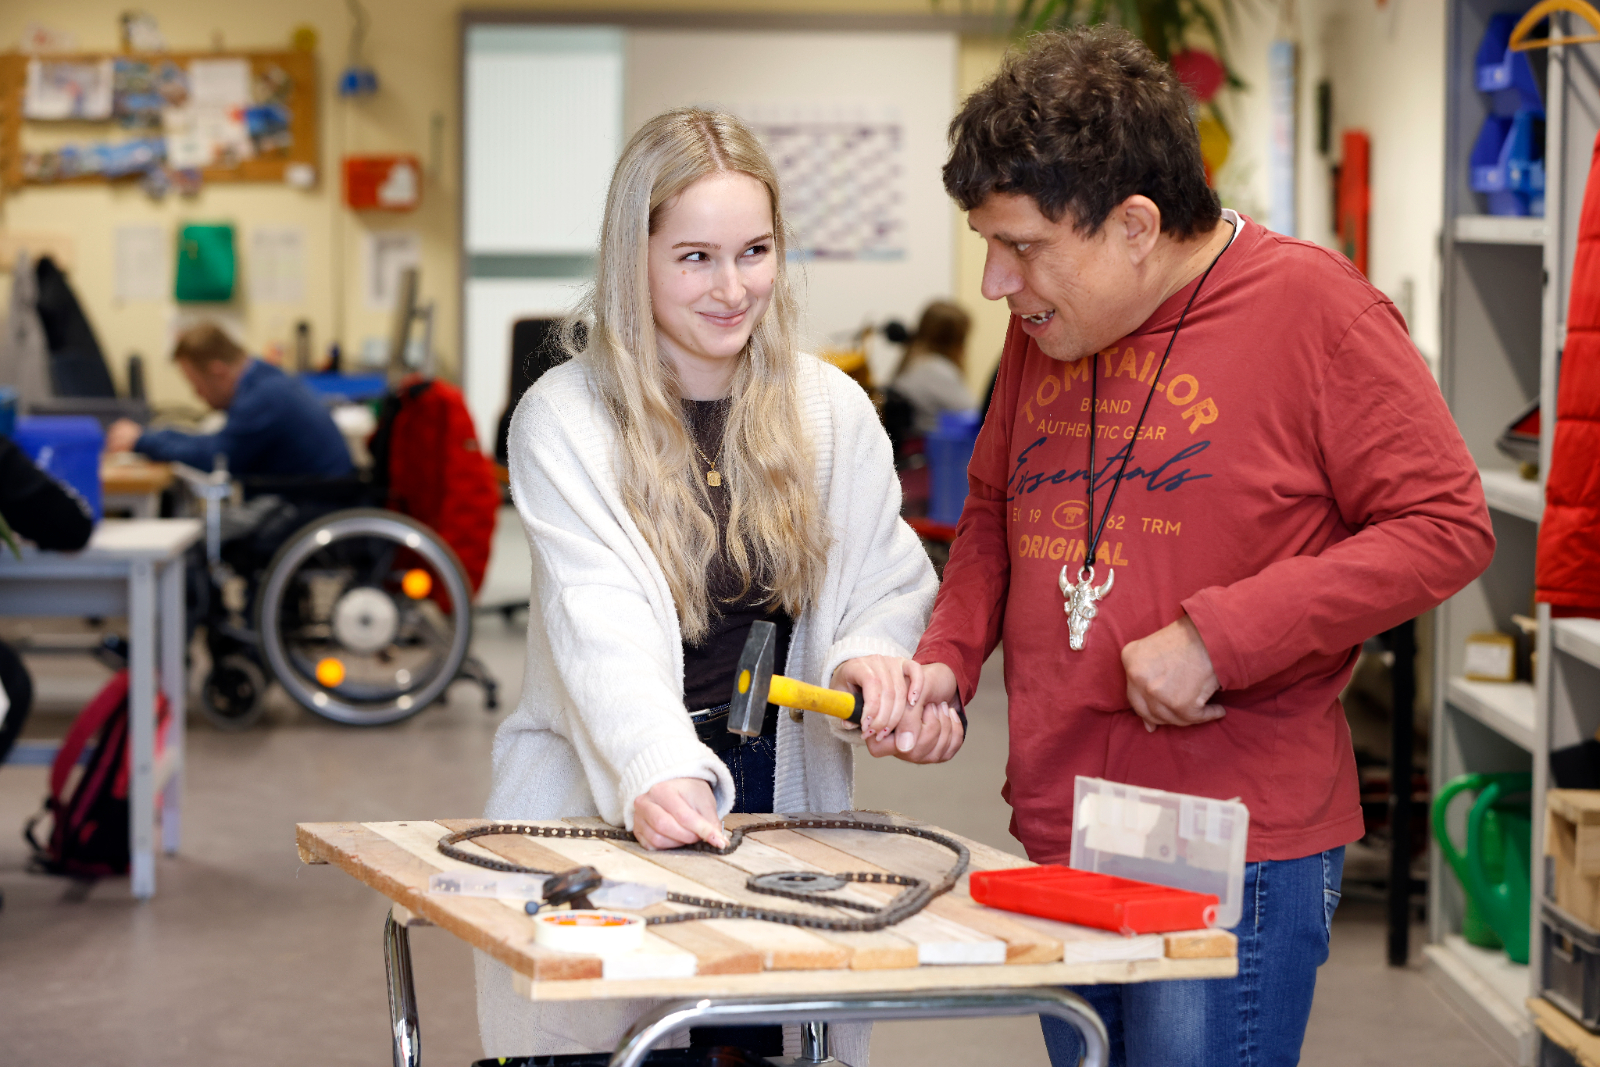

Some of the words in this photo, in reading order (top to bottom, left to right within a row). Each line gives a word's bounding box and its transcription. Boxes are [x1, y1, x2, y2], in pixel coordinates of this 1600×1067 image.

[1018, 357, 1090, 424] TOM
[1098, 346, 1219, 435] TAILOR
[1080, 397, 1132, 414] BRAND
[1036, 418, 1120, 440] AUTHENTIC
[1122, 425, 1167, 440] GEAR
[1006, 436, 1213, 502] Essentials
[1028, 508, 1042, 523] 19
[1106, 514, 1126, 530] 62
[1141, 517, 1182, 536] TRM
[1018, 533, 1129, 567] ORIGINAL
